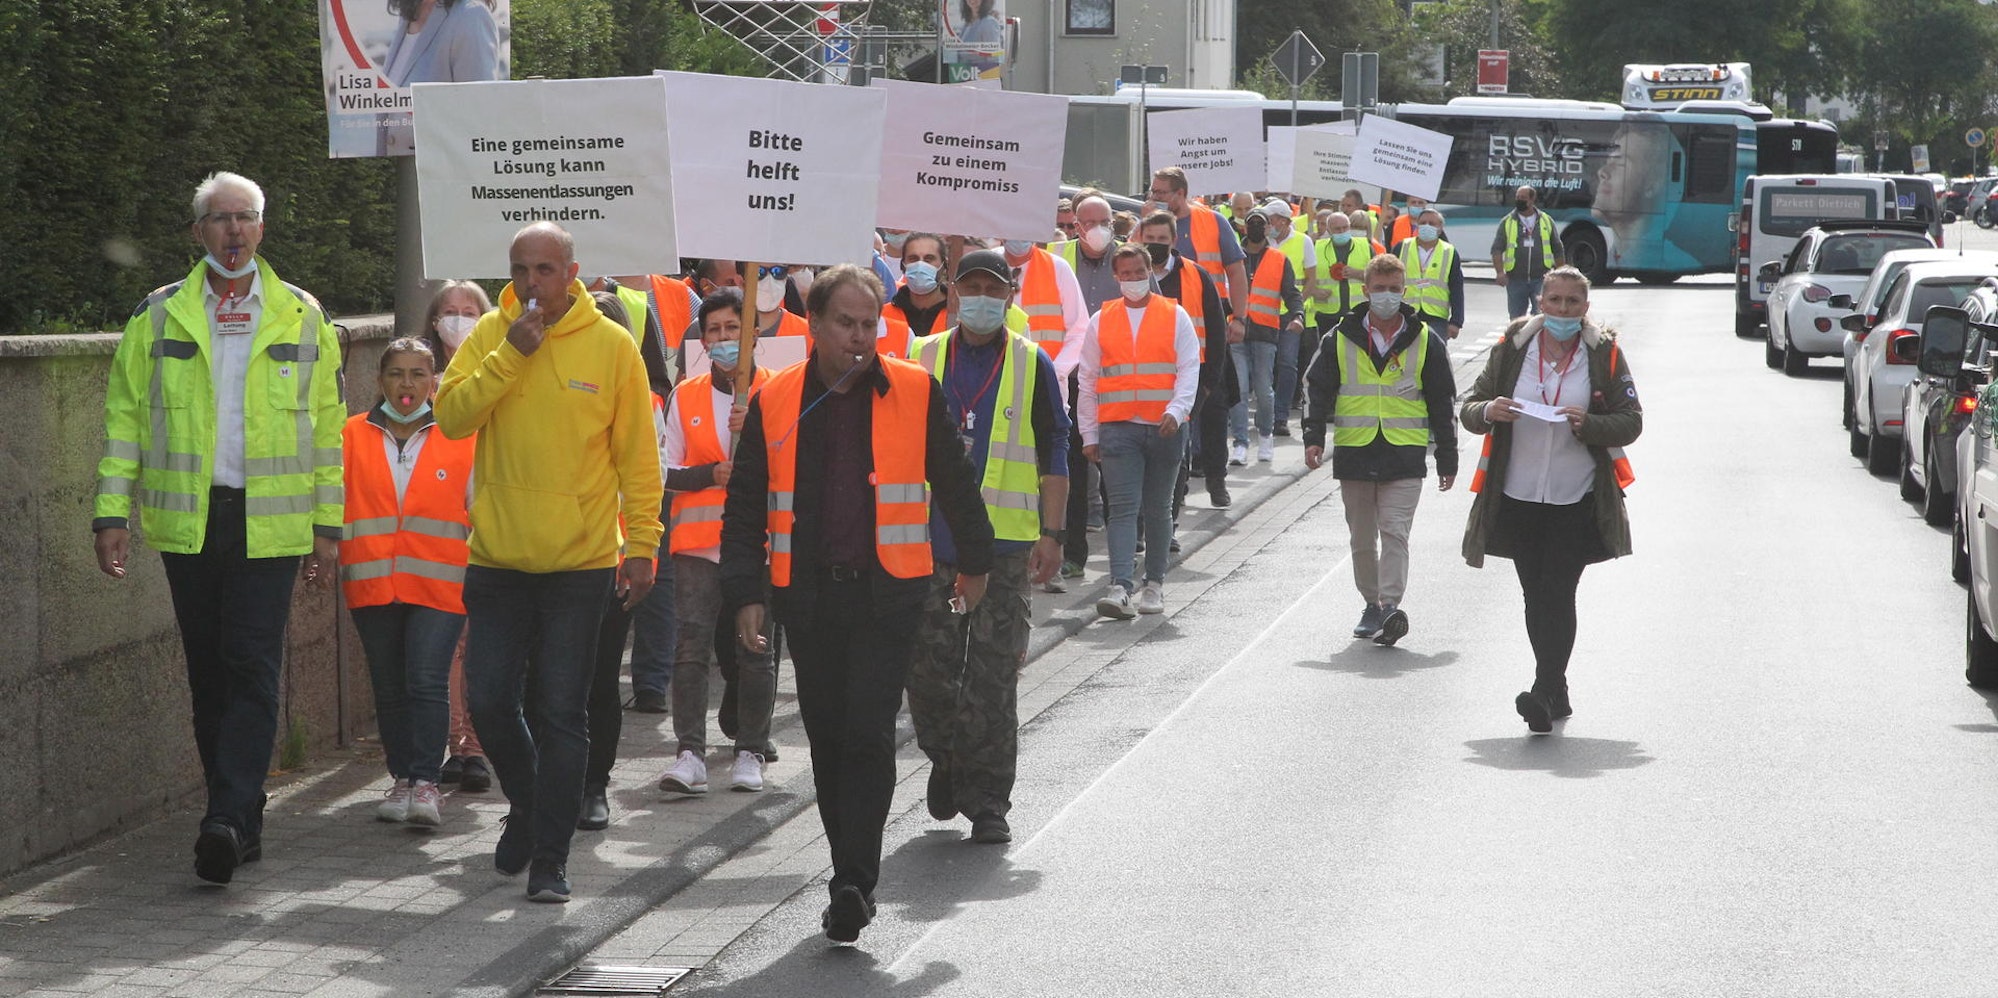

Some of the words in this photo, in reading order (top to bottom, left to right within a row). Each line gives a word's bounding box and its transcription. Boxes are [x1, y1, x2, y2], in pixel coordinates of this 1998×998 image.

[340, 74, 372, 89] Lisa
[951, 66, 981, 81] Volt
[1653, 88, 1720, 100] STINN
[382, 118, 400, 127] den
[471, 138, 507, 153] Eine
[512, 136, 624, 156] gemeinsame
[749, 130, 803, 152] Bitte
[923, 131, 1020, 152] Gemeinsam
[1178, 138, 1195, 146] Wir
[1198, 136, 1228, 145] haben
[1379, 139, 1405, 151] Lassen
[1406, 146, 1417, 154] Sie
[1489, 134, 1584, 159] RSVG
[1180, 149, 1208, 159] Angst
[1372, 148, 1416, 163] gemeinsam
[1417, 159, 1433, 168] eine
[493, 160, 556, 178] Lösung
[561, 159, 605, 173] kann
[746, 159, 800, 181] helft
[932, 155, 951, 168] zu
[956, 155, 1007, 172] einem
[1210, 158, 1233, 170] Jobs!
[1374, 156, 1400, 170] Lösung
[1402, 164, 1427, 176] finden.
[1488, 158, 1583, 173] HYBRID
[916, 172, 1019, 194] Kompromiss
[1487, 175, 1504, 186] Wir
[1505, 175, 1542, 187] reinigen
[1544, 177, 1559, 188] die
[1560, 178, 1583, 191] Luft!
[472, 183, 634, 200] Massenentlassungen
[748, 193, 795, 211] uns!
[1776, 198, 1814, 208] Parkett
[1819, 199, 1860, 209] Dietrich
[502, 207, 605, 222] verhindern.
